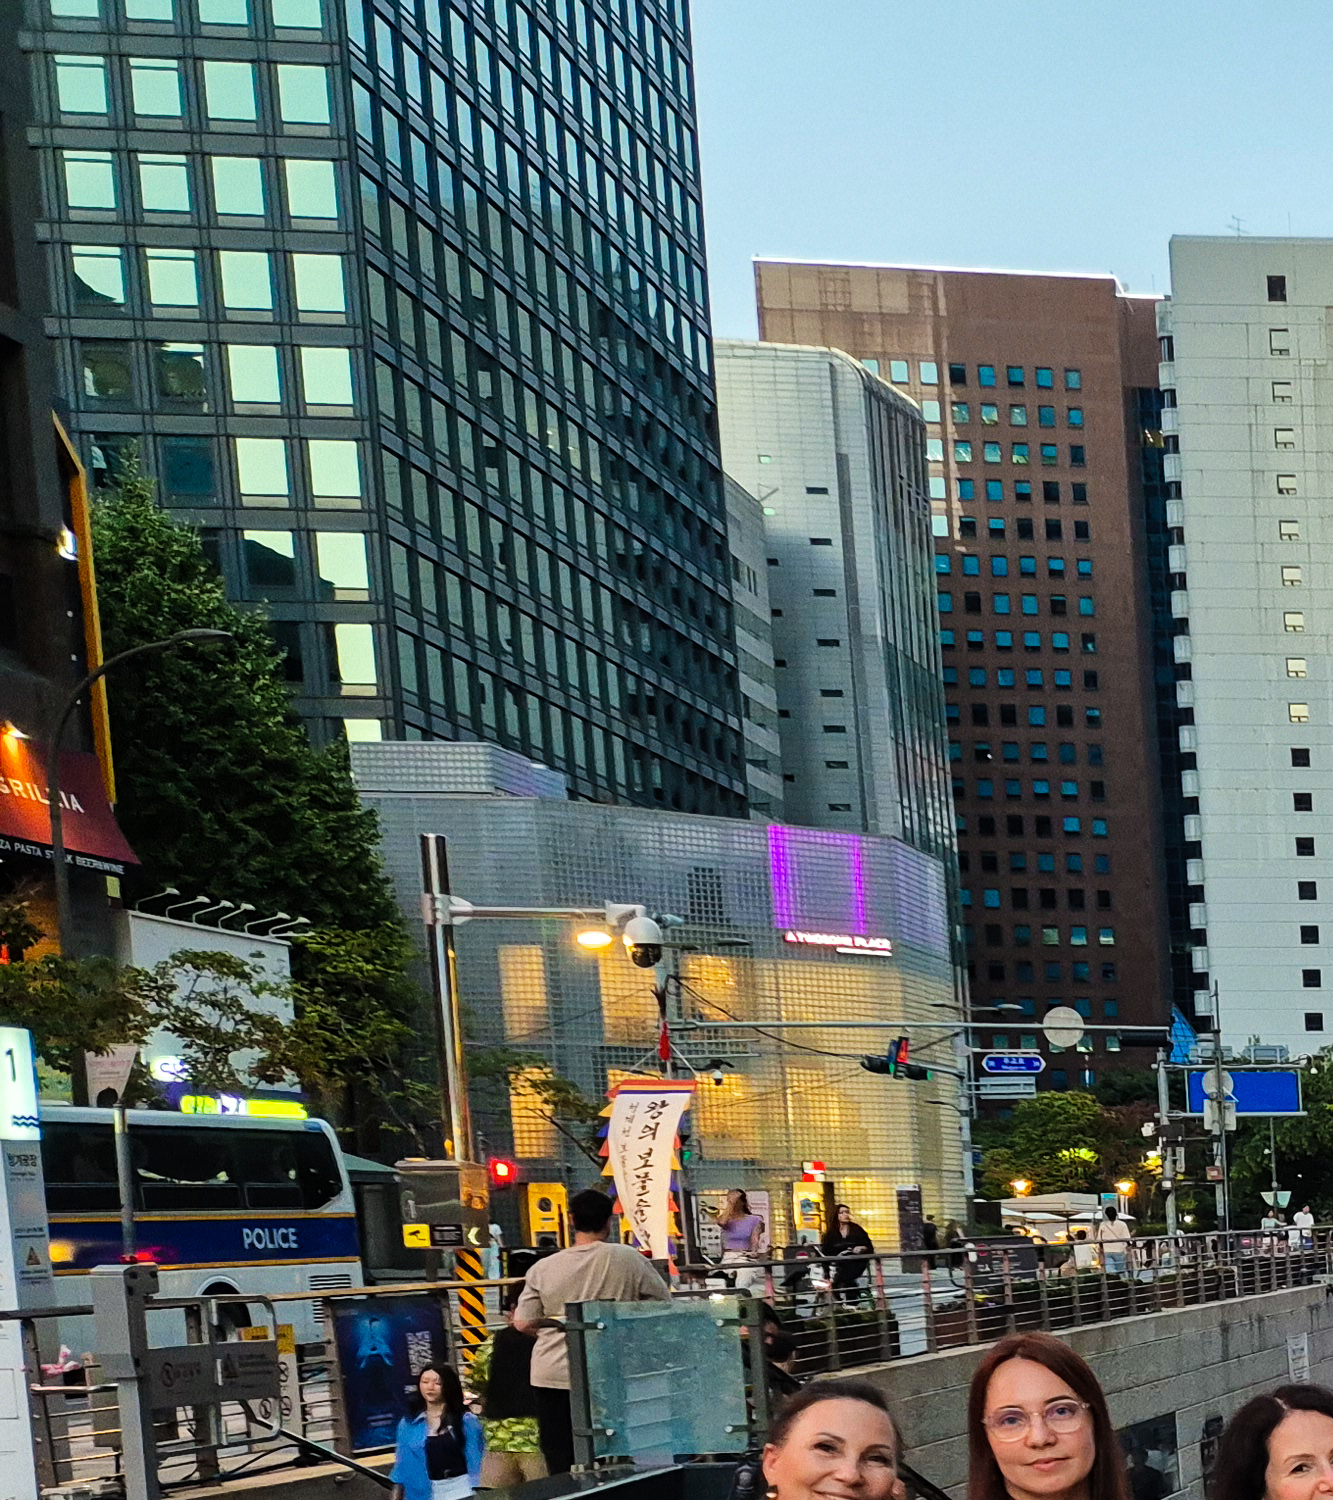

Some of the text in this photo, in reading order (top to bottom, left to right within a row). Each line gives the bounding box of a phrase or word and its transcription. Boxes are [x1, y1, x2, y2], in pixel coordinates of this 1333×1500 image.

[14, 842, 42, 857] PASTA
[45, 850, 73, 864] STK
[638, 1099, 669, 1141] 왕의
[242, 1228, 299, 1250] POLICE
